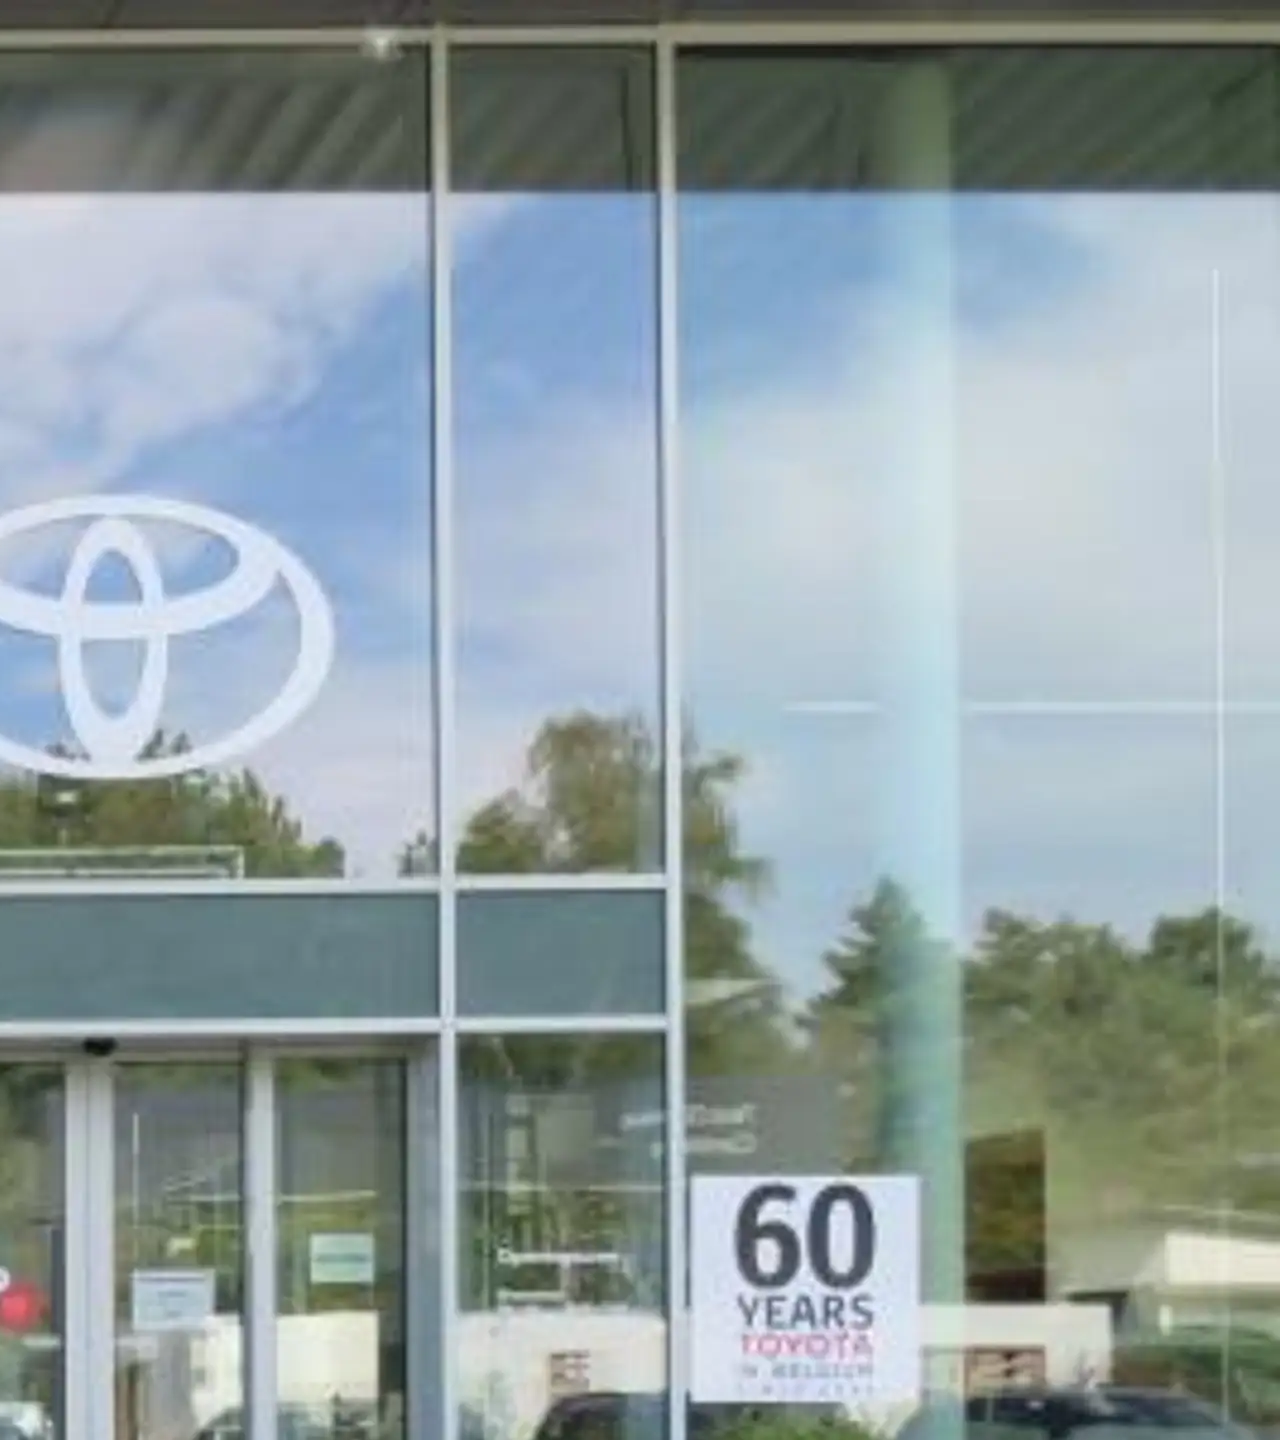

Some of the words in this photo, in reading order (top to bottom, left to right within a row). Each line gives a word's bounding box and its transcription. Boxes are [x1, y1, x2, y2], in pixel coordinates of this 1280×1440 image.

[735, 1183, 876, 1290] 60
[737, 1294, 875, 1330] YEARS
[742, 1333, 873, 1359] TOYOTA
